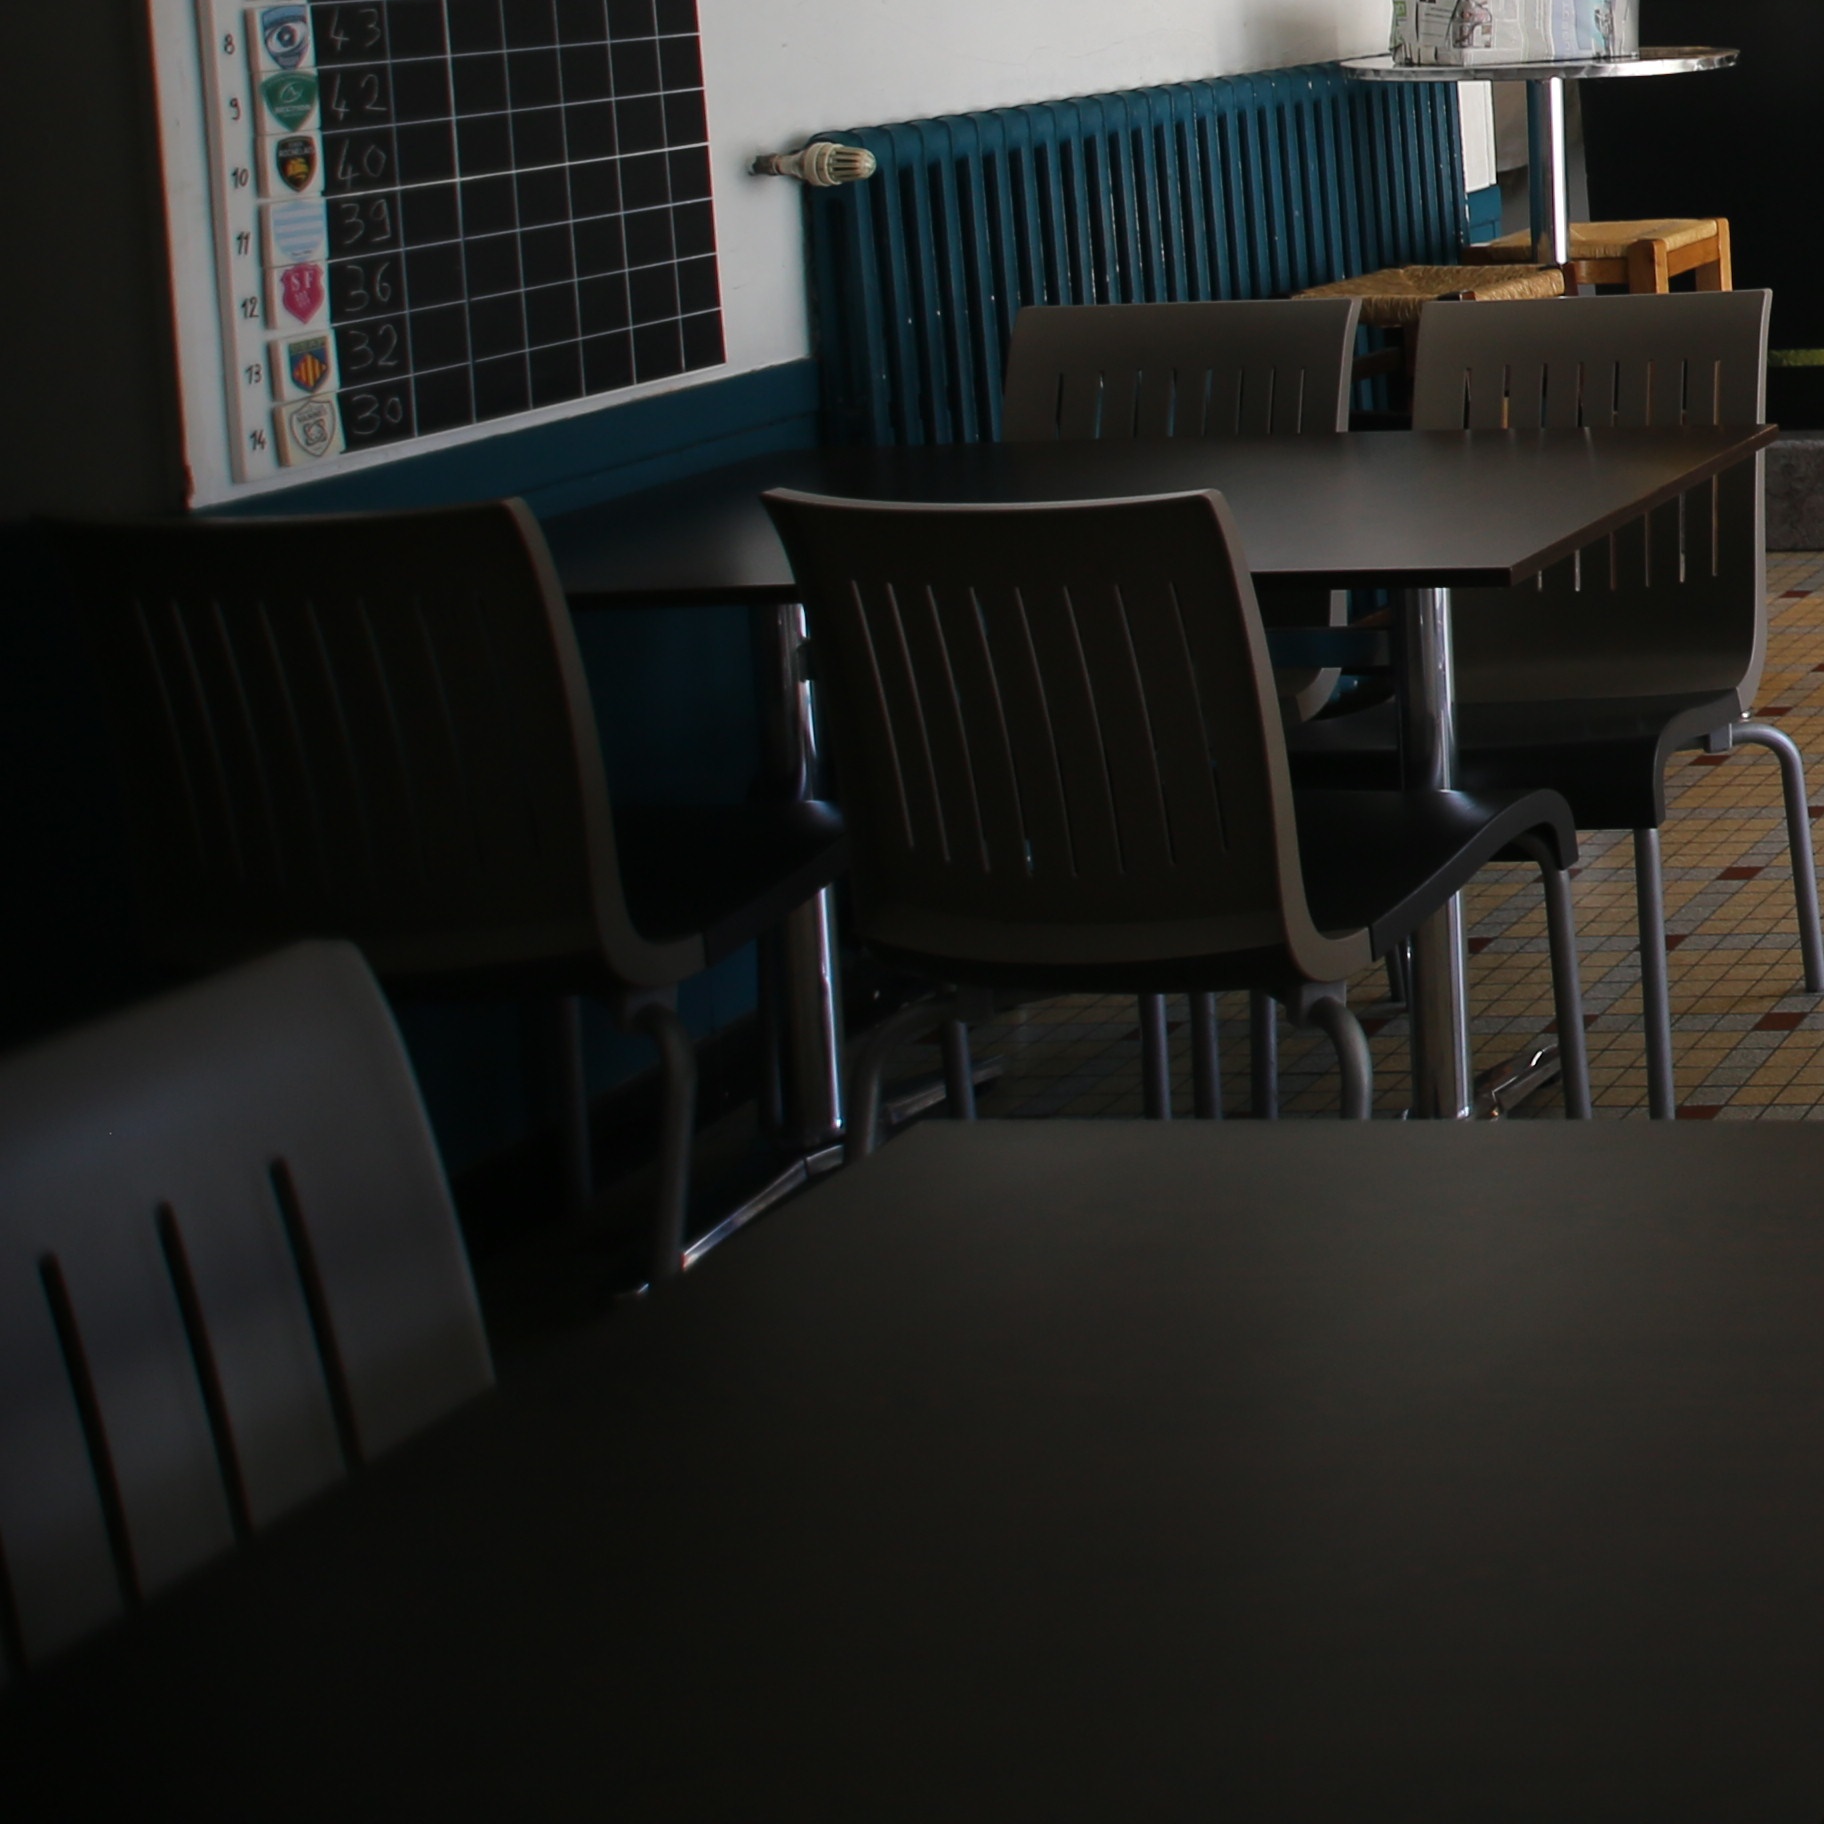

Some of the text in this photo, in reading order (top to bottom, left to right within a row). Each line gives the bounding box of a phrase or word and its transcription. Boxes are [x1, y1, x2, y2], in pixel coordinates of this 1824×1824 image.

[223, 6, 382, 56] 8 43
[230, 72, 388, 122] 9 42
[230, 138, 387, 190] 10 40
[235, 197, 393, 258] 11 39
[240, 261, 393, 320] 12 36
[244, 363, 263, 385] 13
[349, 323, 399, 371] 32
[249, 393, 403, 452] 14 30
